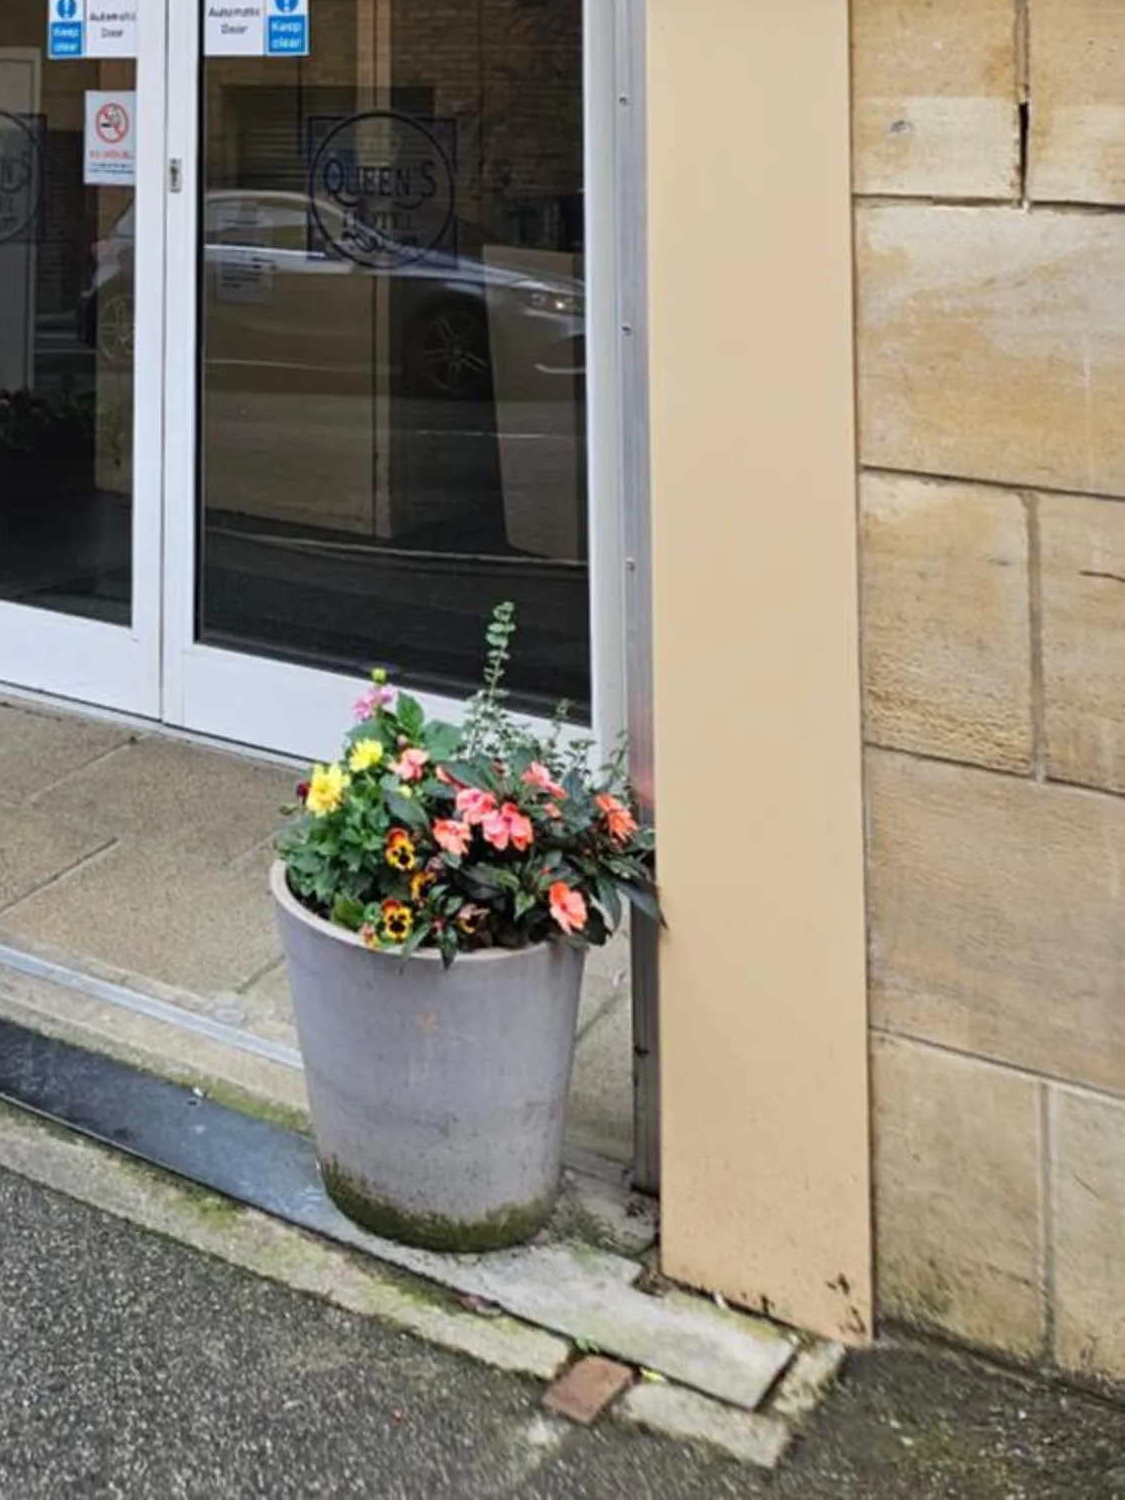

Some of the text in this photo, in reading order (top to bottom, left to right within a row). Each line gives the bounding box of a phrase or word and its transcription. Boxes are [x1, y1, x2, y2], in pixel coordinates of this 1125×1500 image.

[208, 6, 261, 18] Automatic
[220, 23, 249, 35] Door
[271, 21, 302, 34] Keep
[271, 37, 301, 49] clear
[323, 158, 437, 209] QUEEN'S
